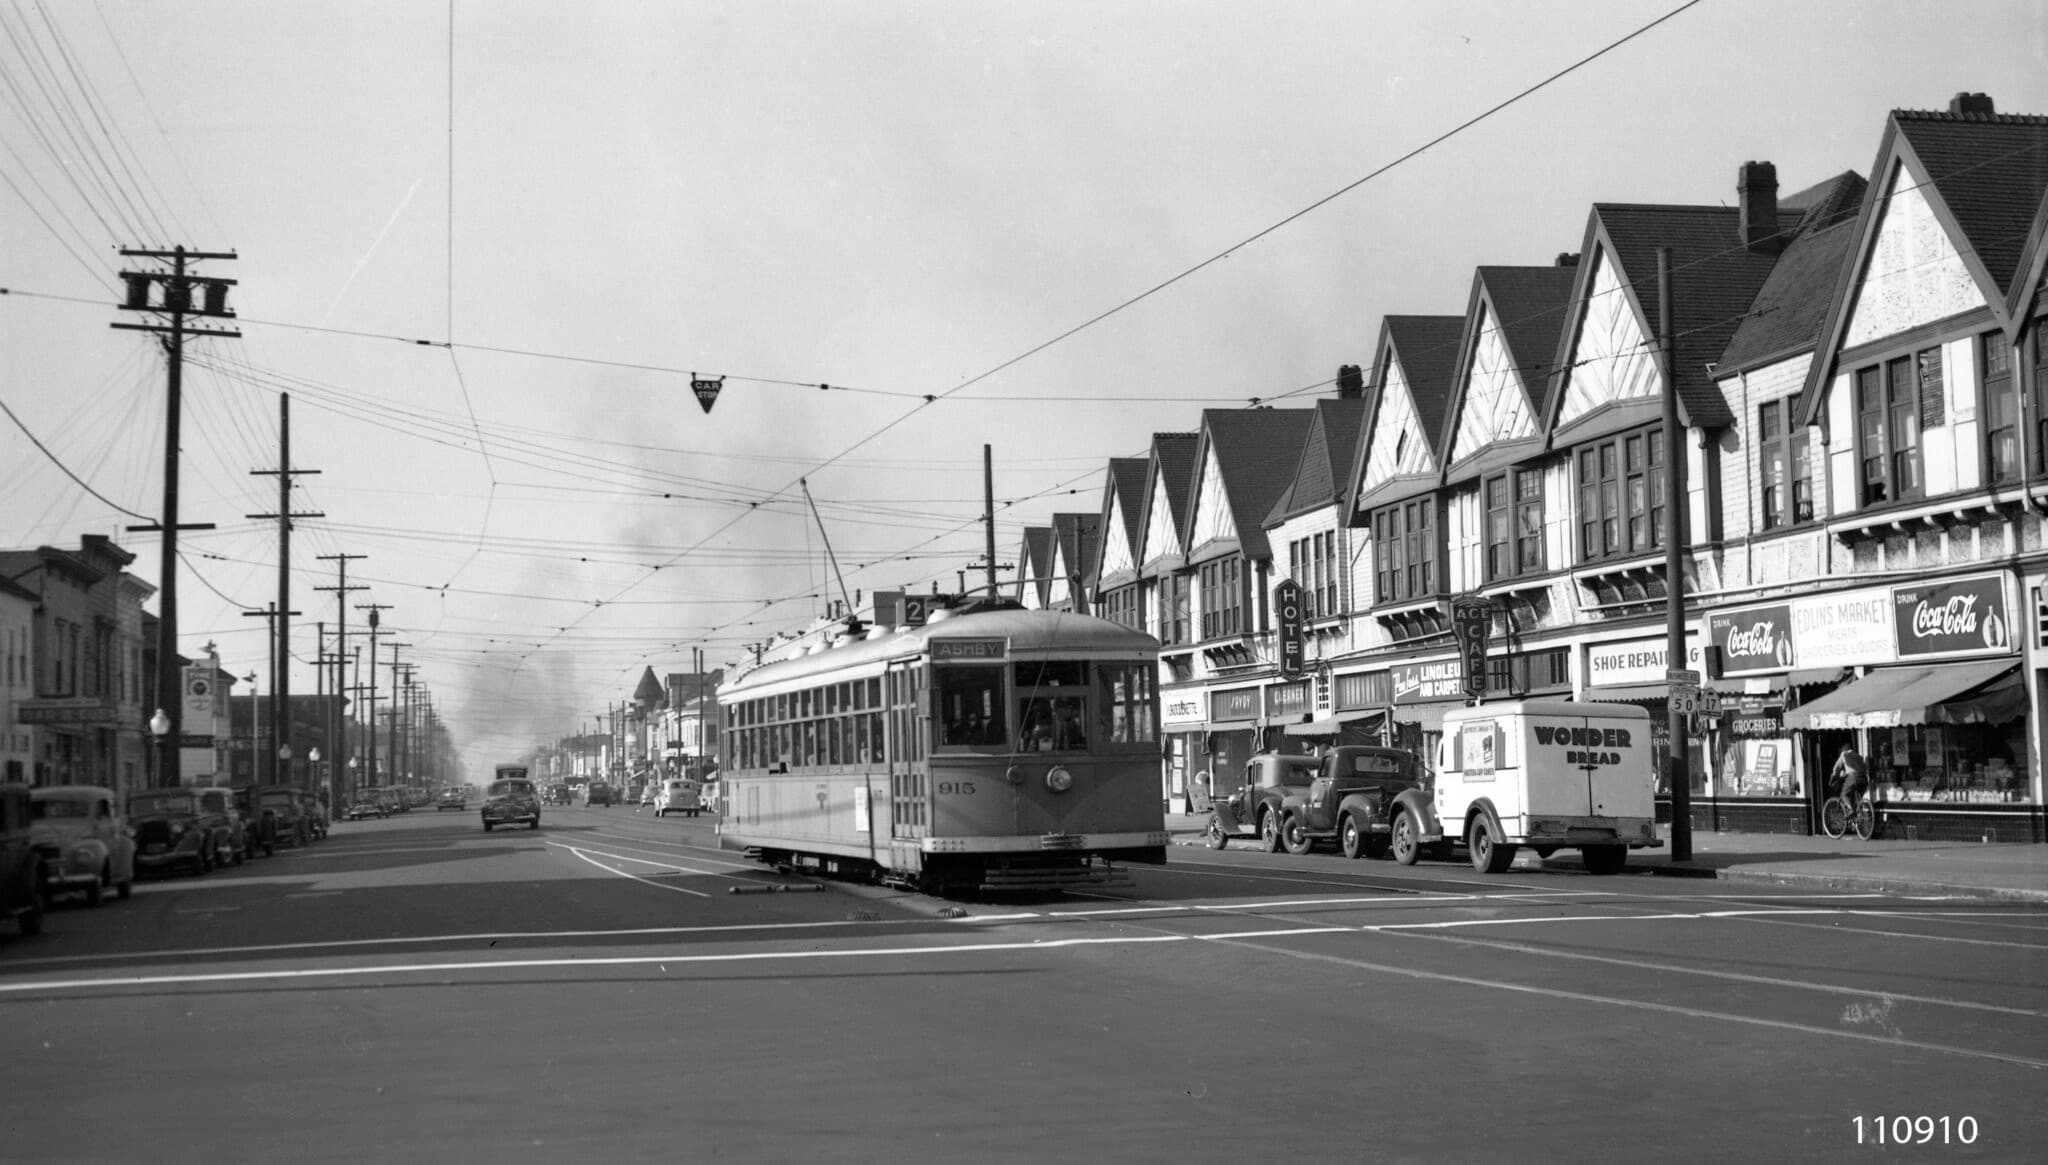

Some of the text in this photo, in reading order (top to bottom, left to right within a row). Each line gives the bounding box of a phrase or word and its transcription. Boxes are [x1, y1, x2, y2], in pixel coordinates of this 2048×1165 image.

[695, 382, 719, 390] CAR
[1896, 593, 1918, 605] DRINK
[906, 601, 923, 621] 2
[1457, 607, 1490, 621] ACE
[1837, 598, 1887, 625] MARKET
[1912, 593, 1978, 639] Coca-Cola
[1283, 588, 1300, 672] HOTEL
[1726, 620, 1774, 659] Coca-Cola
[940, 642, 998, 657] ASHBY
[1468, 624, 1482, 690] CAFE
[1593, 646, 1699, 672] SHOE REPAIG
[1420, 661, 1461, 681] LINOLEU
[1420, 682, 1434, 697] AND
[1675, 698, 1693, 712] 50
[1706, 698, 1716, 711] 17
[1732, 718, 1777, 735] GROCERIES
[1534, 726, 1632, 748] WONDER
[1566, 751, 1621, 765] BREAD
[938, 782, 977, 796] 915
